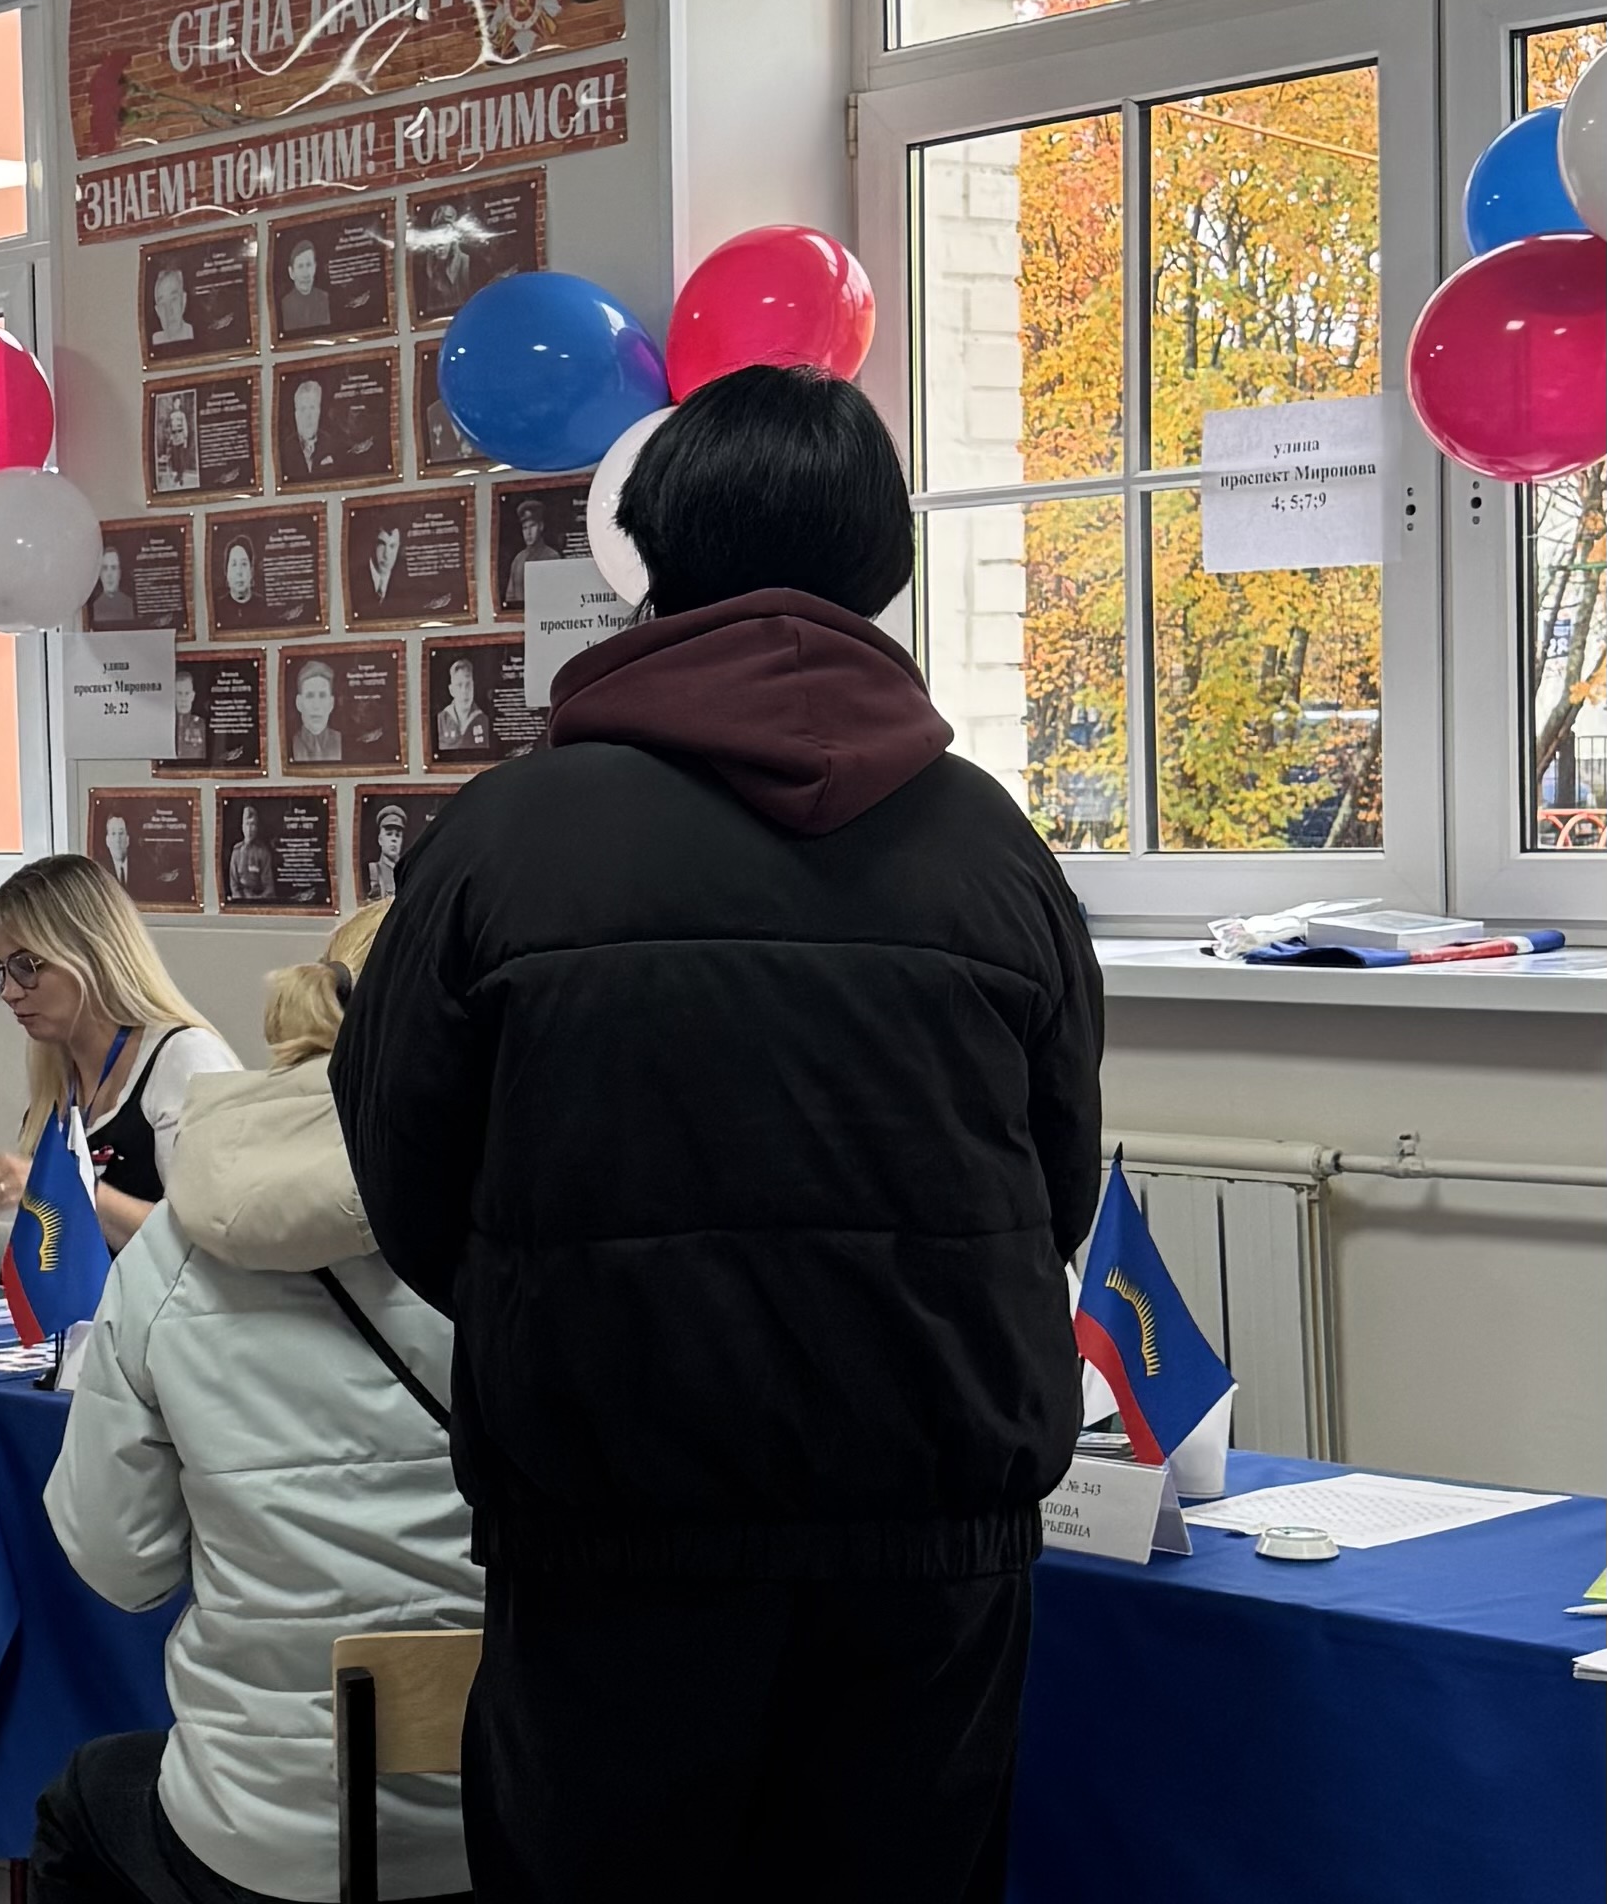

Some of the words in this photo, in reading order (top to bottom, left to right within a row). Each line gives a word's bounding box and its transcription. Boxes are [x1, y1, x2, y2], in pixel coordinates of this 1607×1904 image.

[83, 160, 196, 230] ЗНАЕМ!
[212, 121, 378, 206] ПОМНИМ!
[394, 73, 616, 170] ГОРДИМСЯ!
[1273, 439, 1320, 458] улица
[1220, 470, 1290, 491] проспект
[1295, 463, 1377, 484] Миронова
[1271, 496, 1286, 512] 4;
[1290, 492, 1327, 512] 5;7;9
[580, 592, 617, 607] улица
[540, 619, 594, 635] проспект
[74, 683, 112, 696] проспект
[115, 680, 162, 696] Миронова
[1081, 1482, 1101, 1497] 343
[1039, 1501, 1079, 1519] ПОВА
[1042, 1519, 1091, 1538] РЬЕВНА
